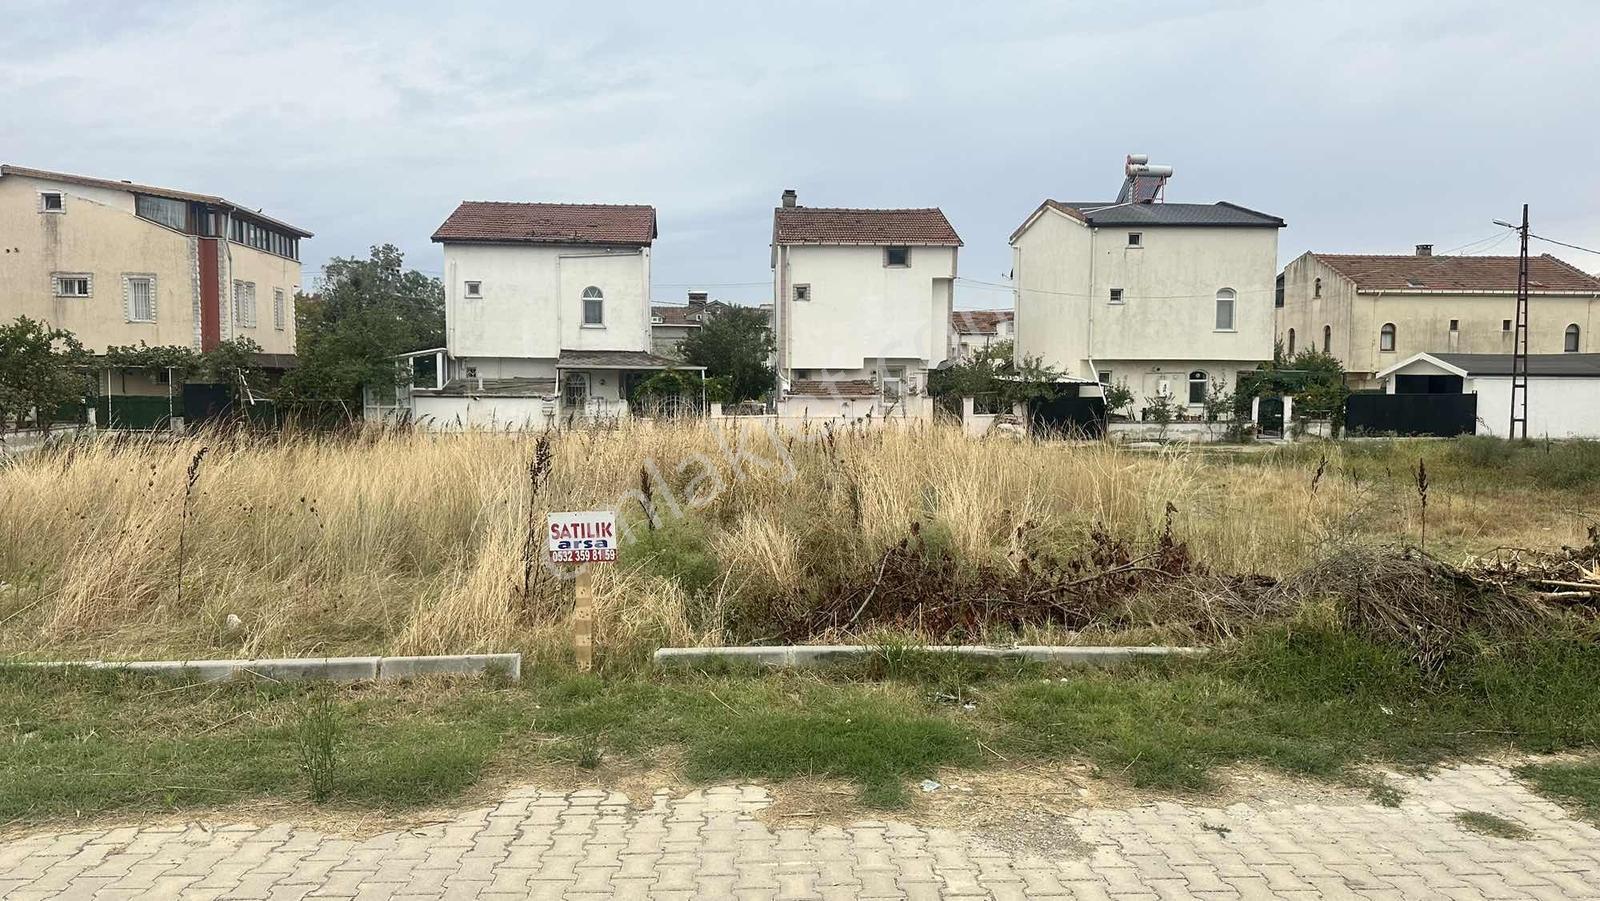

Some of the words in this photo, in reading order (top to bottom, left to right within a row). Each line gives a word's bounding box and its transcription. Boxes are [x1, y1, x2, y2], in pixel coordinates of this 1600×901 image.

[551, 522, 613, 540] SATILIK
[558, 539, 608, 549] arsa
[552, 550, 573, 562] 0532
[575, 550, 590, 561] 359
[592, 550, 602, 561] 81
[605, 549, 616, 561] 59
